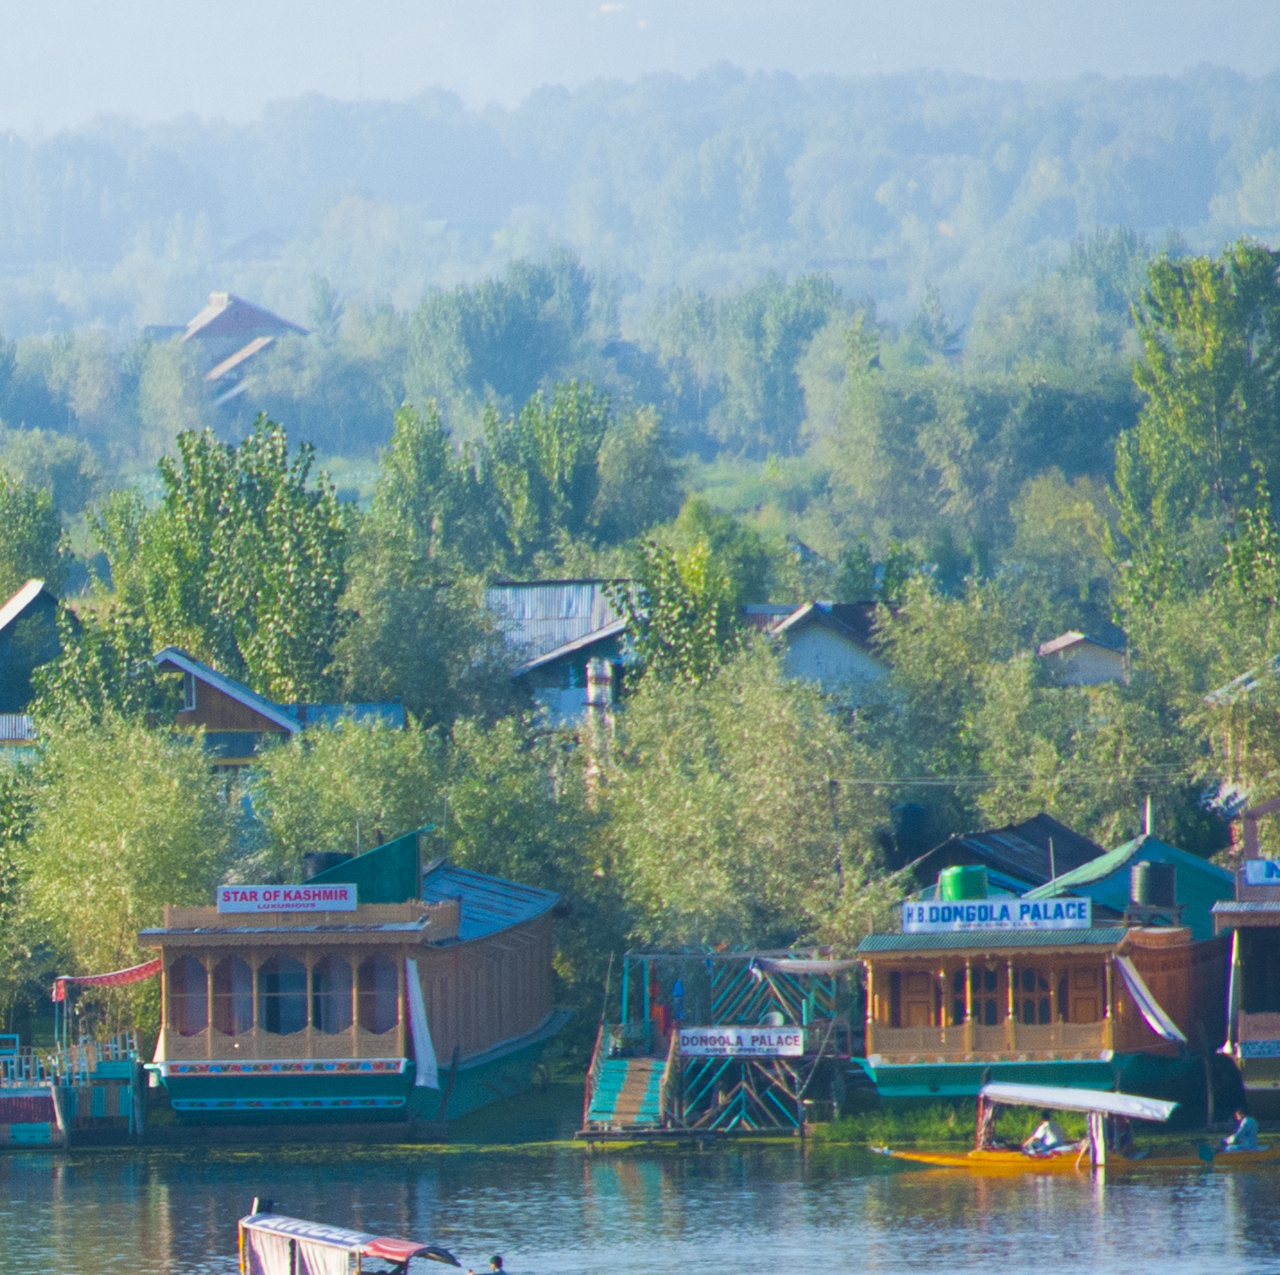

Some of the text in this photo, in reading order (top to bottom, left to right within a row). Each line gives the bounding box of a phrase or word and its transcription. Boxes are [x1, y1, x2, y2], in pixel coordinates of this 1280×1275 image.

[222, 889, 348, 902] STAR OF KASHMIR
[929, 905, 1010, 923] DONGOLA
[1019, 902, 1087, 921] PALACE
[681, 1035, 800, 1047] DONGOLA PALACE
[253, 1218, 364, 1243] AIRCEL
